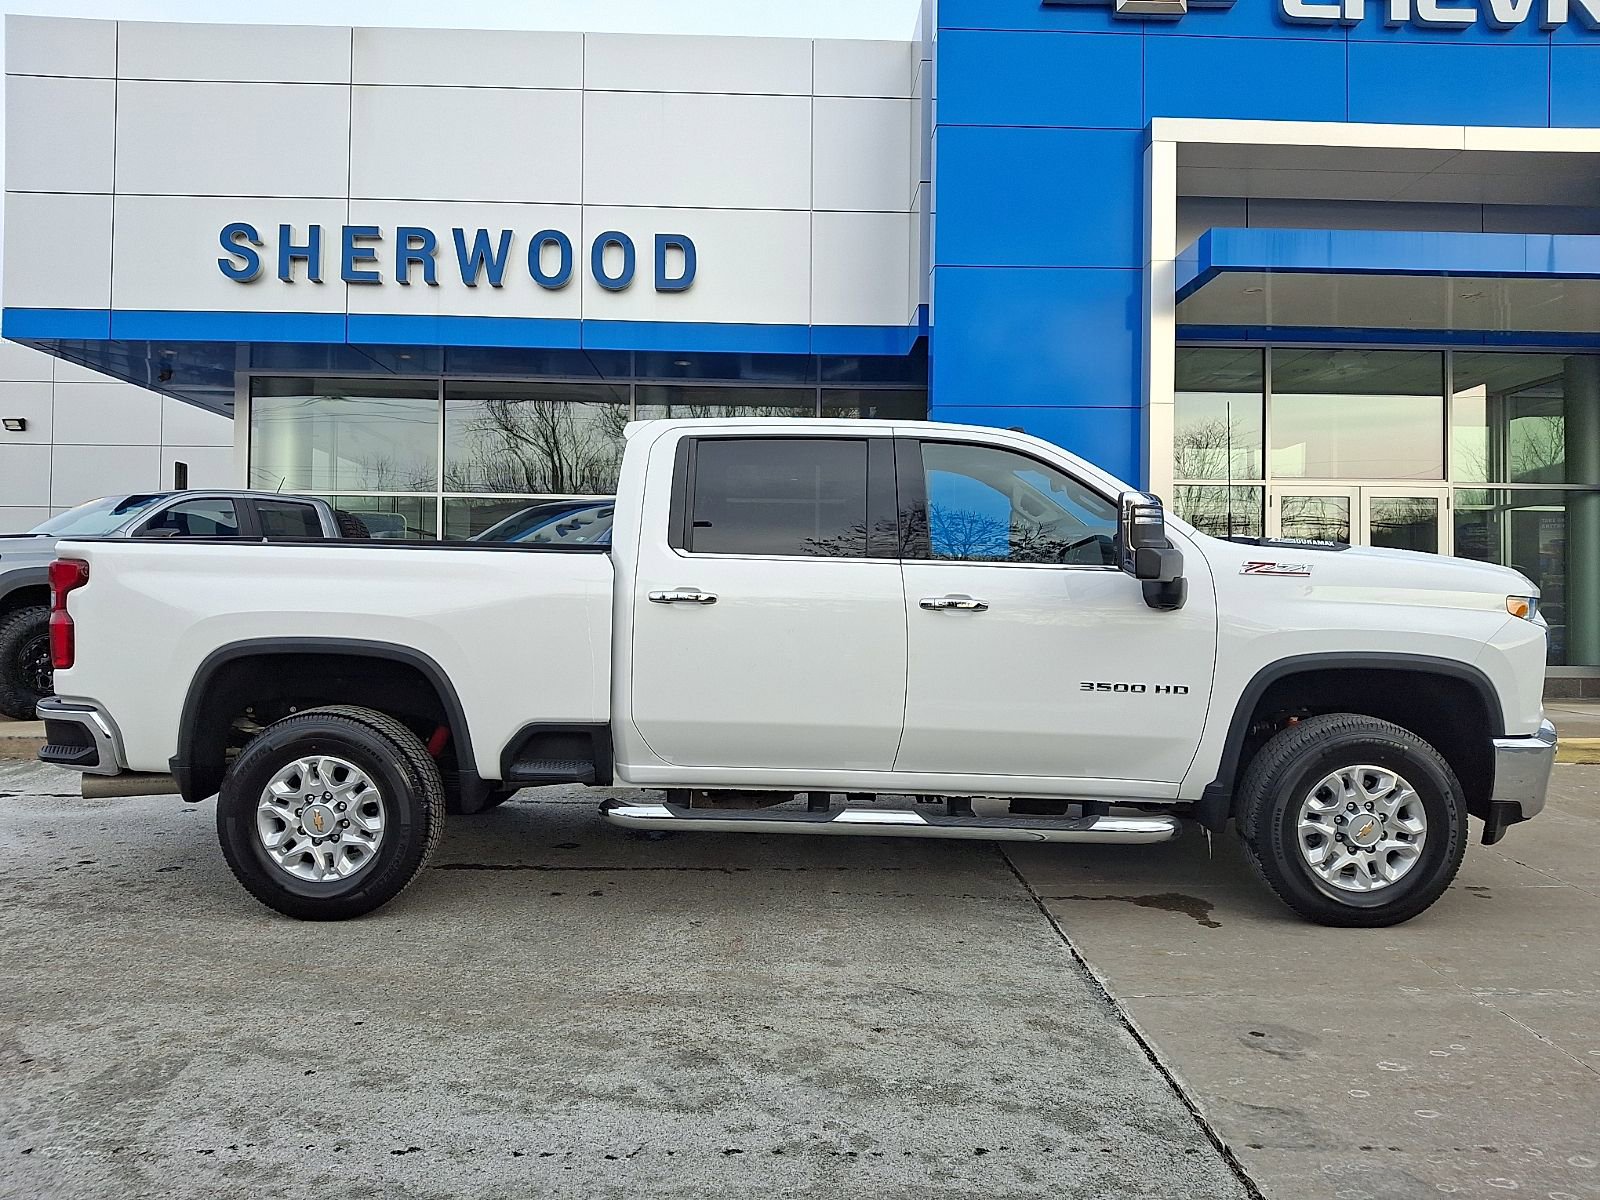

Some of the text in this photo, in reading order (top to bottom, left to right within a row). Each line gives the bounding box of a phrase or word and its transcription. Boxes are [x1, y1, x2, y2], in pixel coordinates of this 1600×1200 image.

[217, 222, 698, 293] SHERWOOD
[1239, 560, 1314, 577] Z71
[1079, 681, 1189, 695] 3500 HD
